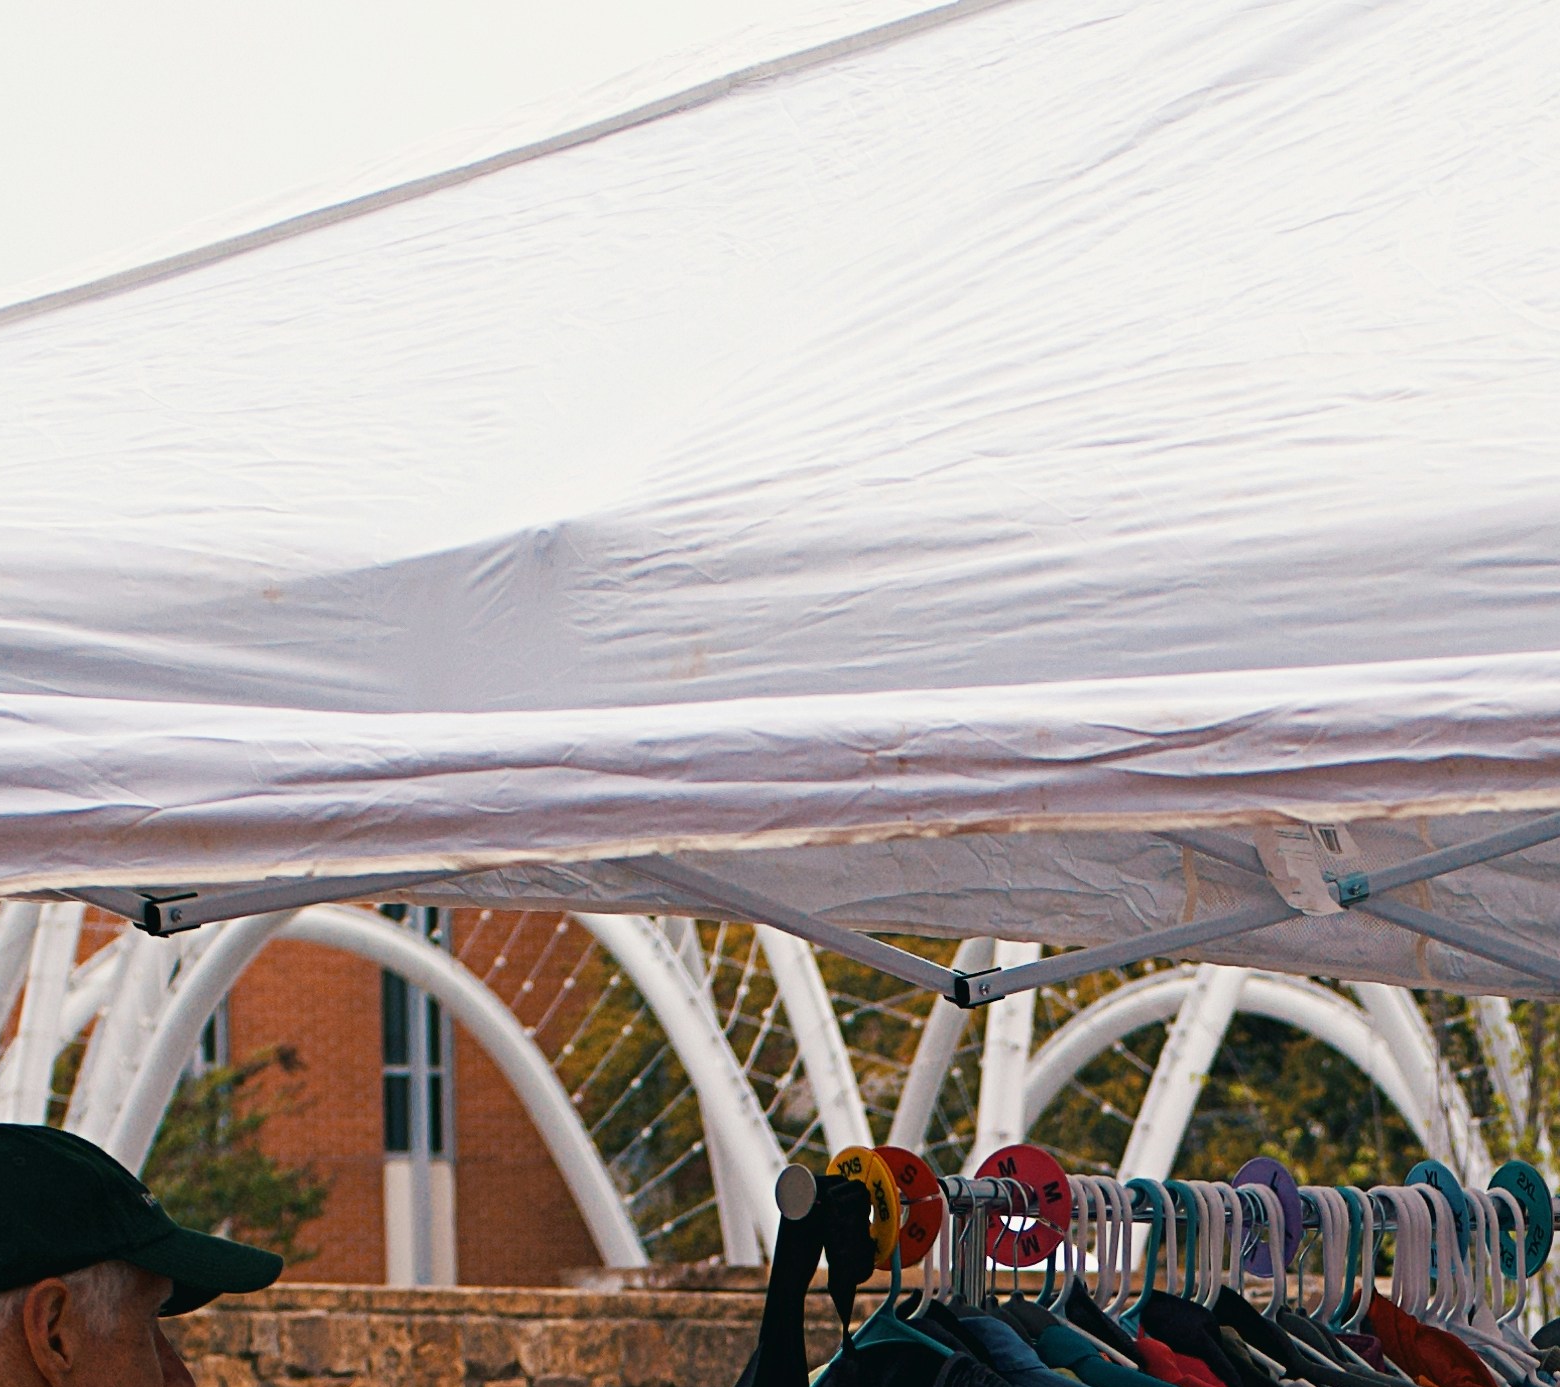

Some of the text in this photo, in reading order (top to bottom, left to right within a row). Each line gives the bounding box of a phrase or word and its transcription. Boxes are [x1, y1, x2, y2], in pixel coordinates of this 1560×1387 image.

[901, 1164, 918, 1185] S
[997, 1157, 1017, 1177] M
[1424, 1169, 1443, 1191] XL
[1515, 1171, 1538, 1202] 2XL
[1043, 1181, 1063, 1203] M
[907, 1223, 927, 1242] S
[1527, 1223, 1545, 1257] 2XL
[1021, 1234, 1040, 1257] M
[1500, 1246, 1514, 1269] 2X
